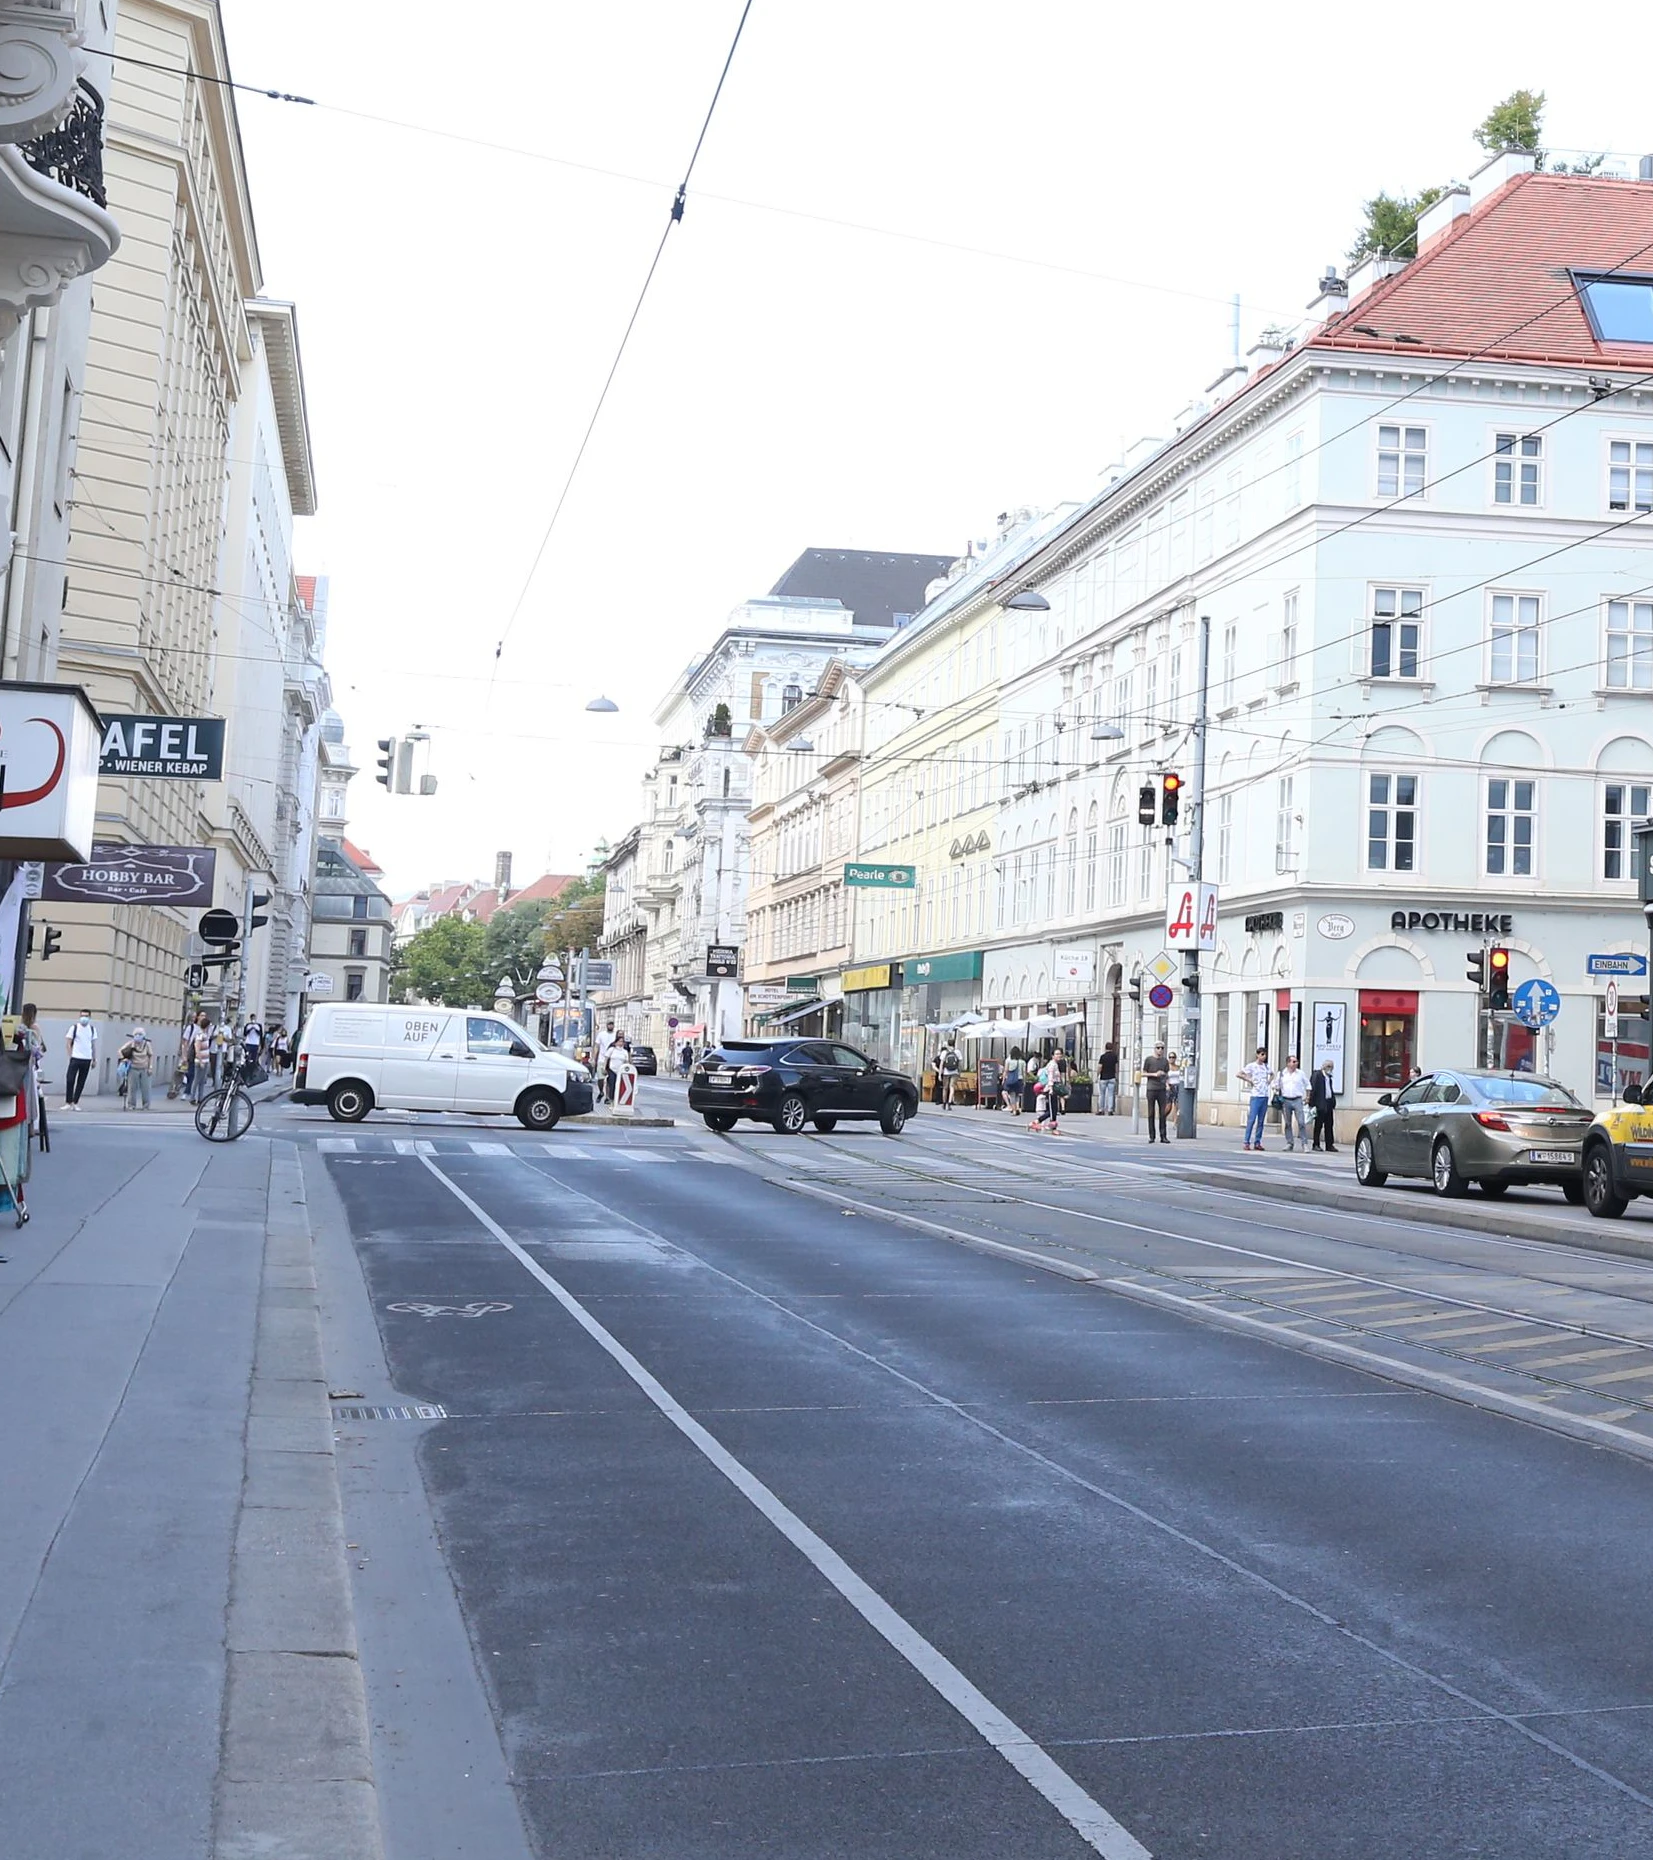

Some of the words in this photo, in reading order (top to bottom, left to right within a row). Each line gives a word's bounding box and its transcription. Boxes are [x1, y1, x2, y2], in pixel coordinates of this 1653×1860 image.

[114, 760, 163, 773] WIENER
[166, 762, 208, 775] KEBAP
[82, 869, 142, 883] HOBBY
[143, 871, 175, 885] BAR
[849, 868, 885, 881] Pearle
[1391, 910, 1513, 933] APOTHEKE
[1594, 960, 1629, 970] EINBAHN
[404, 1020, 439, 1032] OBEN
[403, 1032, 428, 1042] AUF
